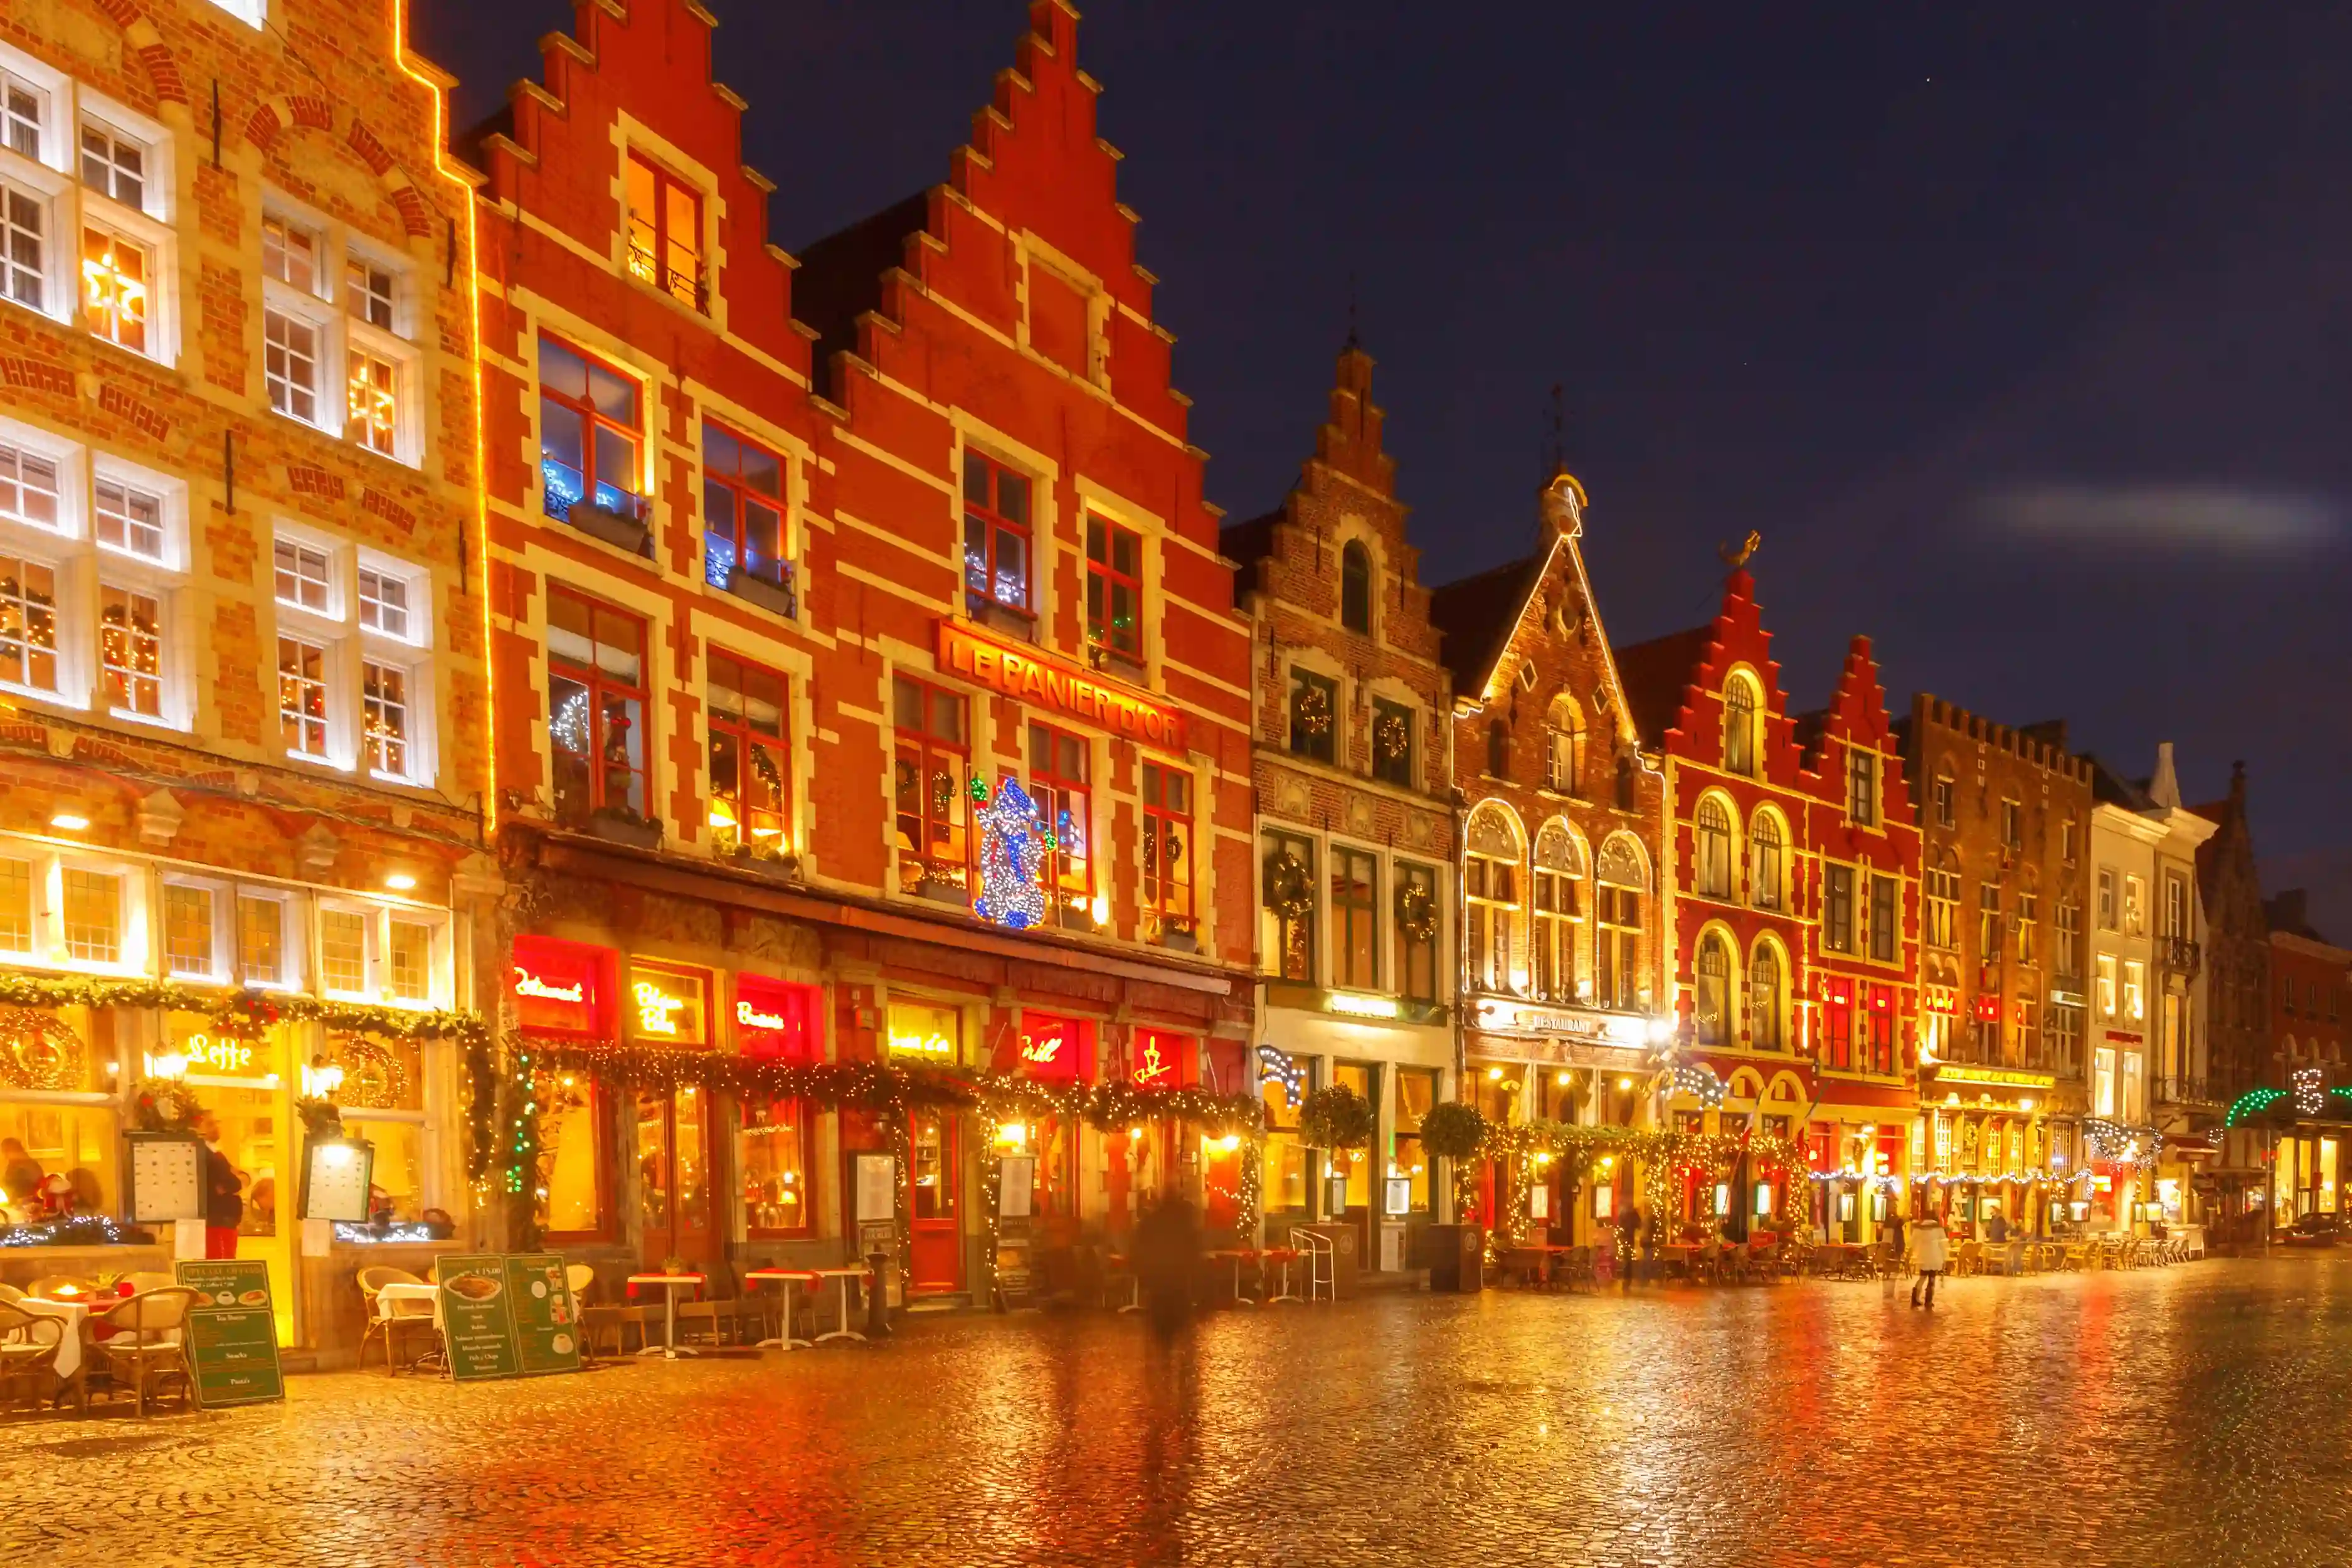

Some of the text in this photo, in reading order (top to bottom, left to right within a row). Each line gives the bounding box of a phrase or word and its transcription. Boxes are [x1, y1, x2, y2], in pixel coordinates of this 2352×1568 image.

[950, 641, 1179, 748] LE PANIER D'OR
[1533, 1015, 1591, 1034] RESTAURANT
[186, 1033, 252, 1070] Leffe
